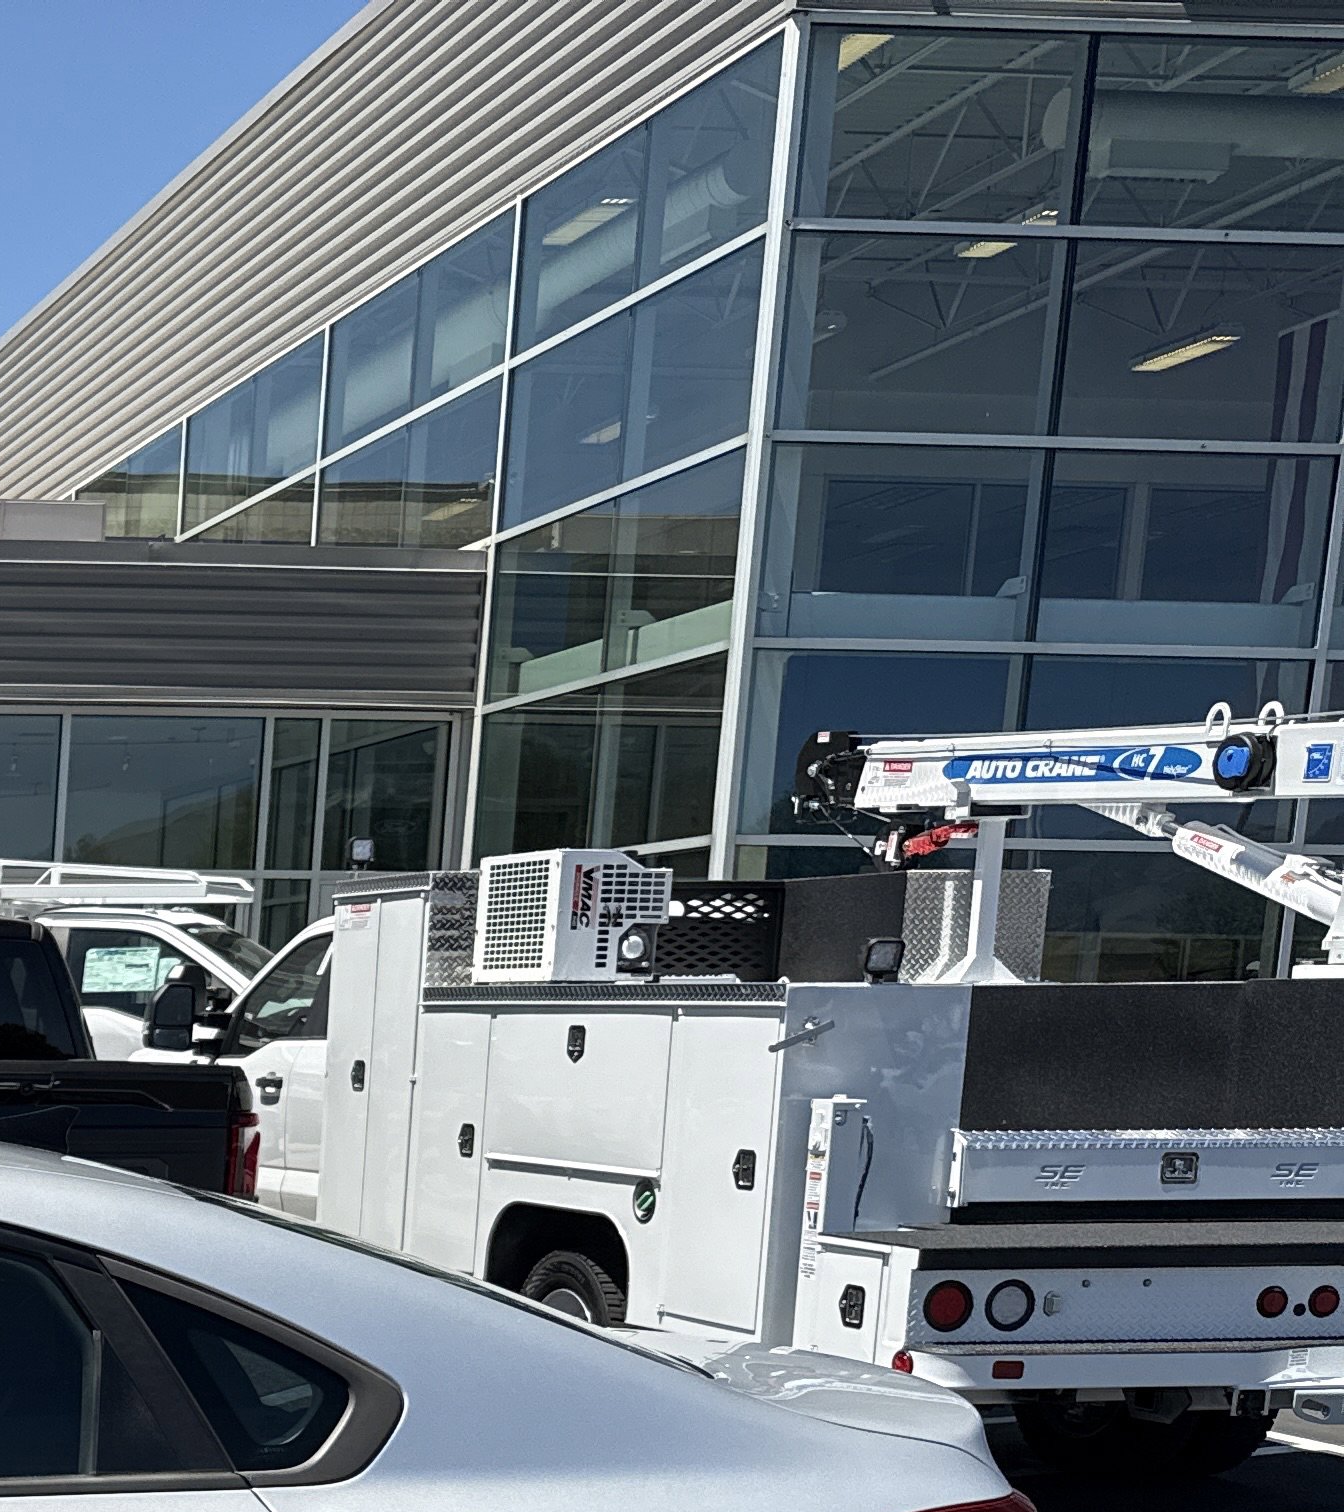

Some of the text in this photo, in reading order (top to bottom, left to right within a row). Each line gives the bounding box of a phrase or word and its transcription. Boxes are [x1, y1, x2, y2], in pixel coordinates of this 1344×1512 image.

[966, 756, 1101, 780] AUTO CRANE
[1130, 753, 1148, 768] HC
[579, 866, 598, 928] VMAC
[1035, 1164, 1087, 1183] SE
[1269, 1162, 1320, 1181] SE
